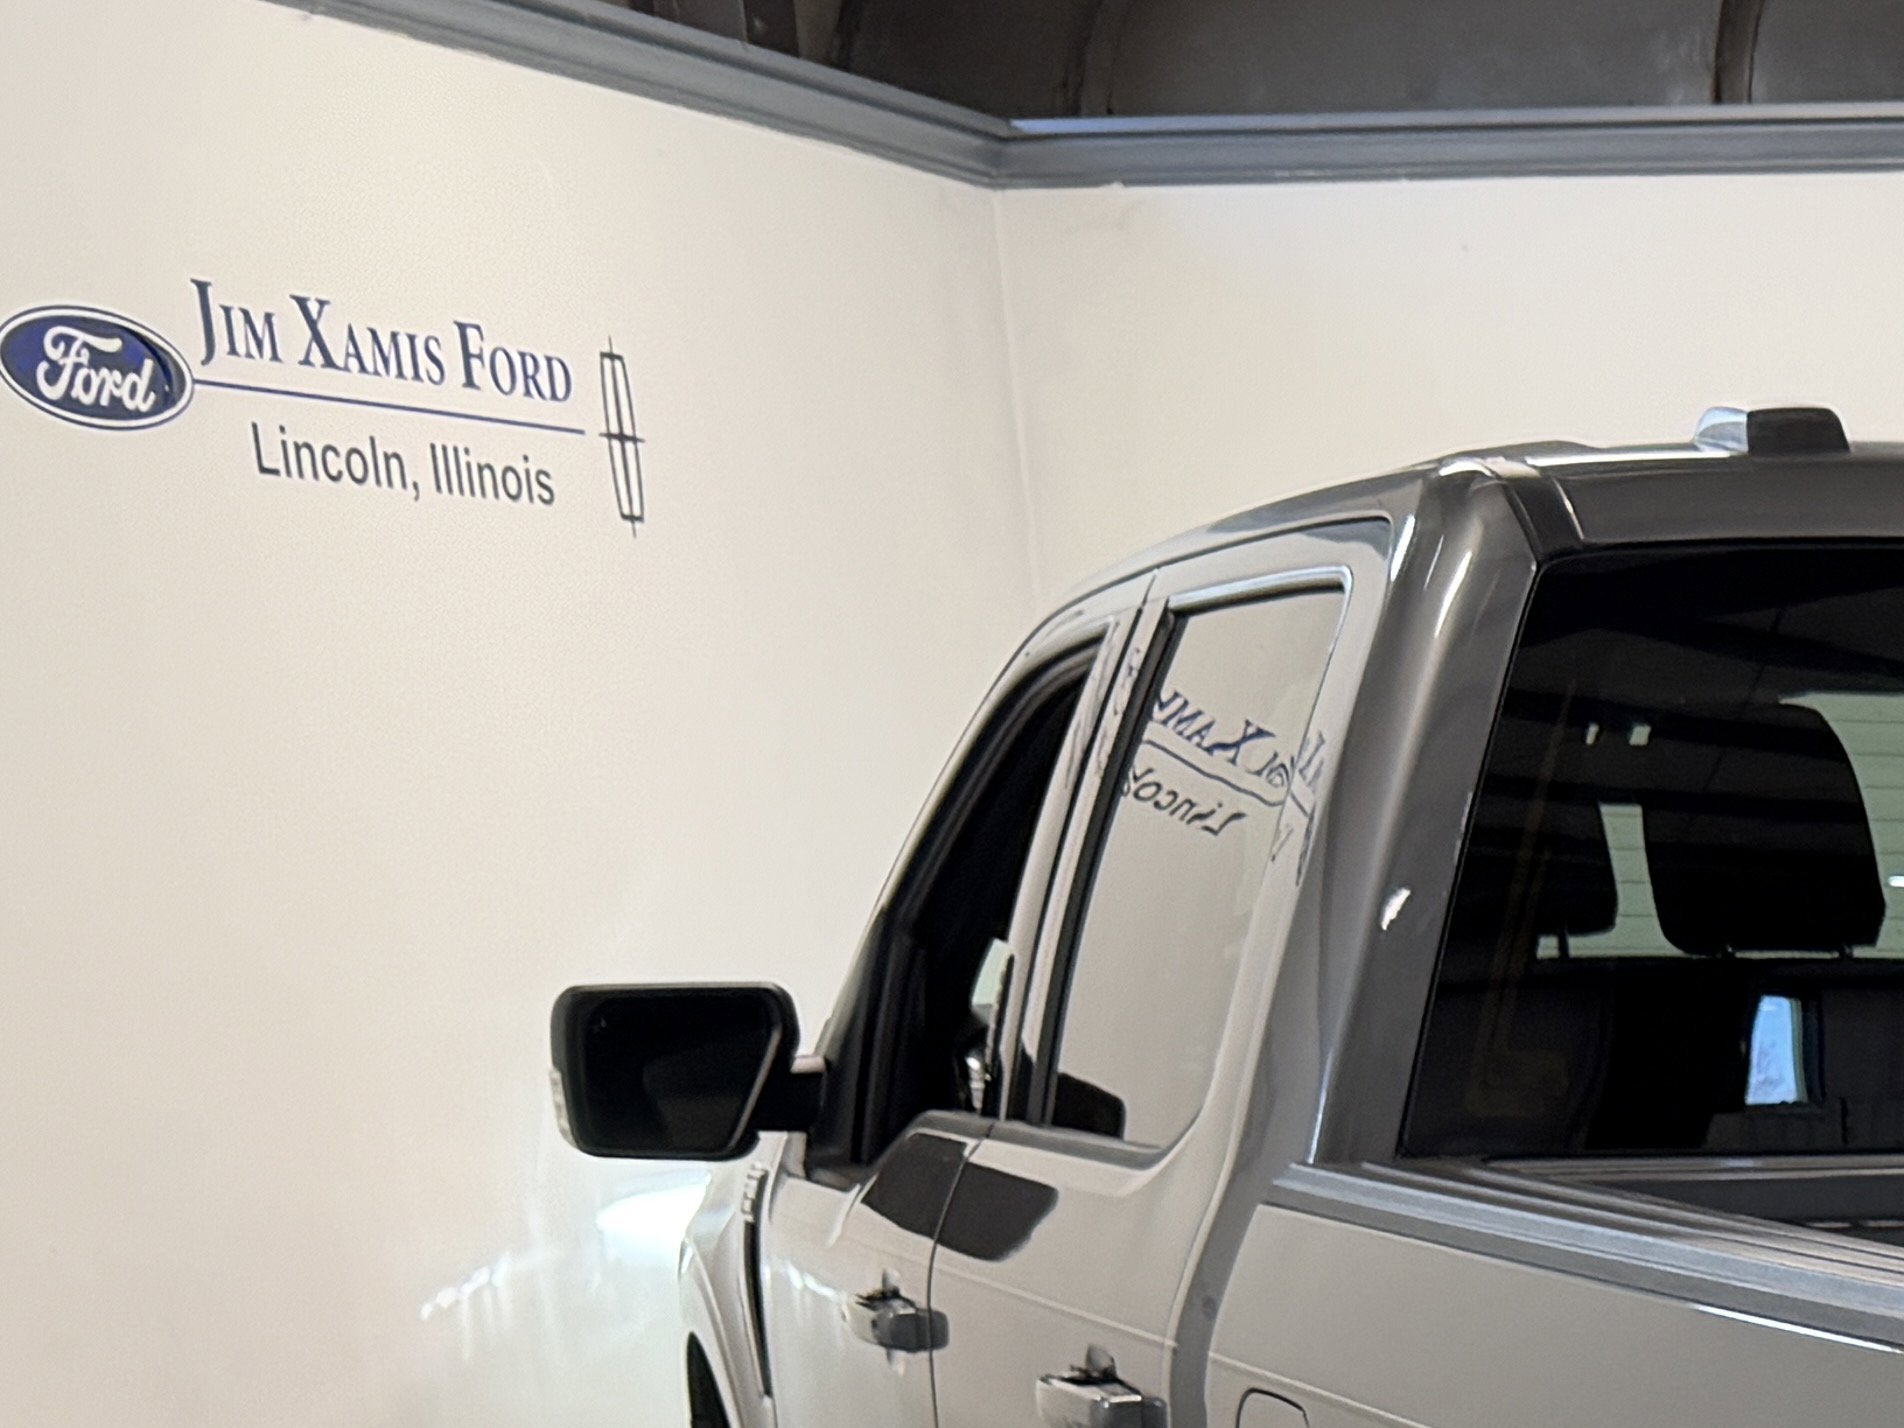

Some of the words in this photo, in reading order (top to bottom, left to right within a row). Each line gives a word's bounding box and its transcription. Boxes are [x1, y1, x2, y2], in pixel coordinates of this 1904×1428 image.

[36, 325, 156, 412] Ford
[189, 278, 283, 367] JIM
[289, 294, 446, 386] XAMIS
[453, 320, 572, 402] FORD
[251, 421, 420, 502] Lincoln,
[429, 442, 555, 506] Illinois
